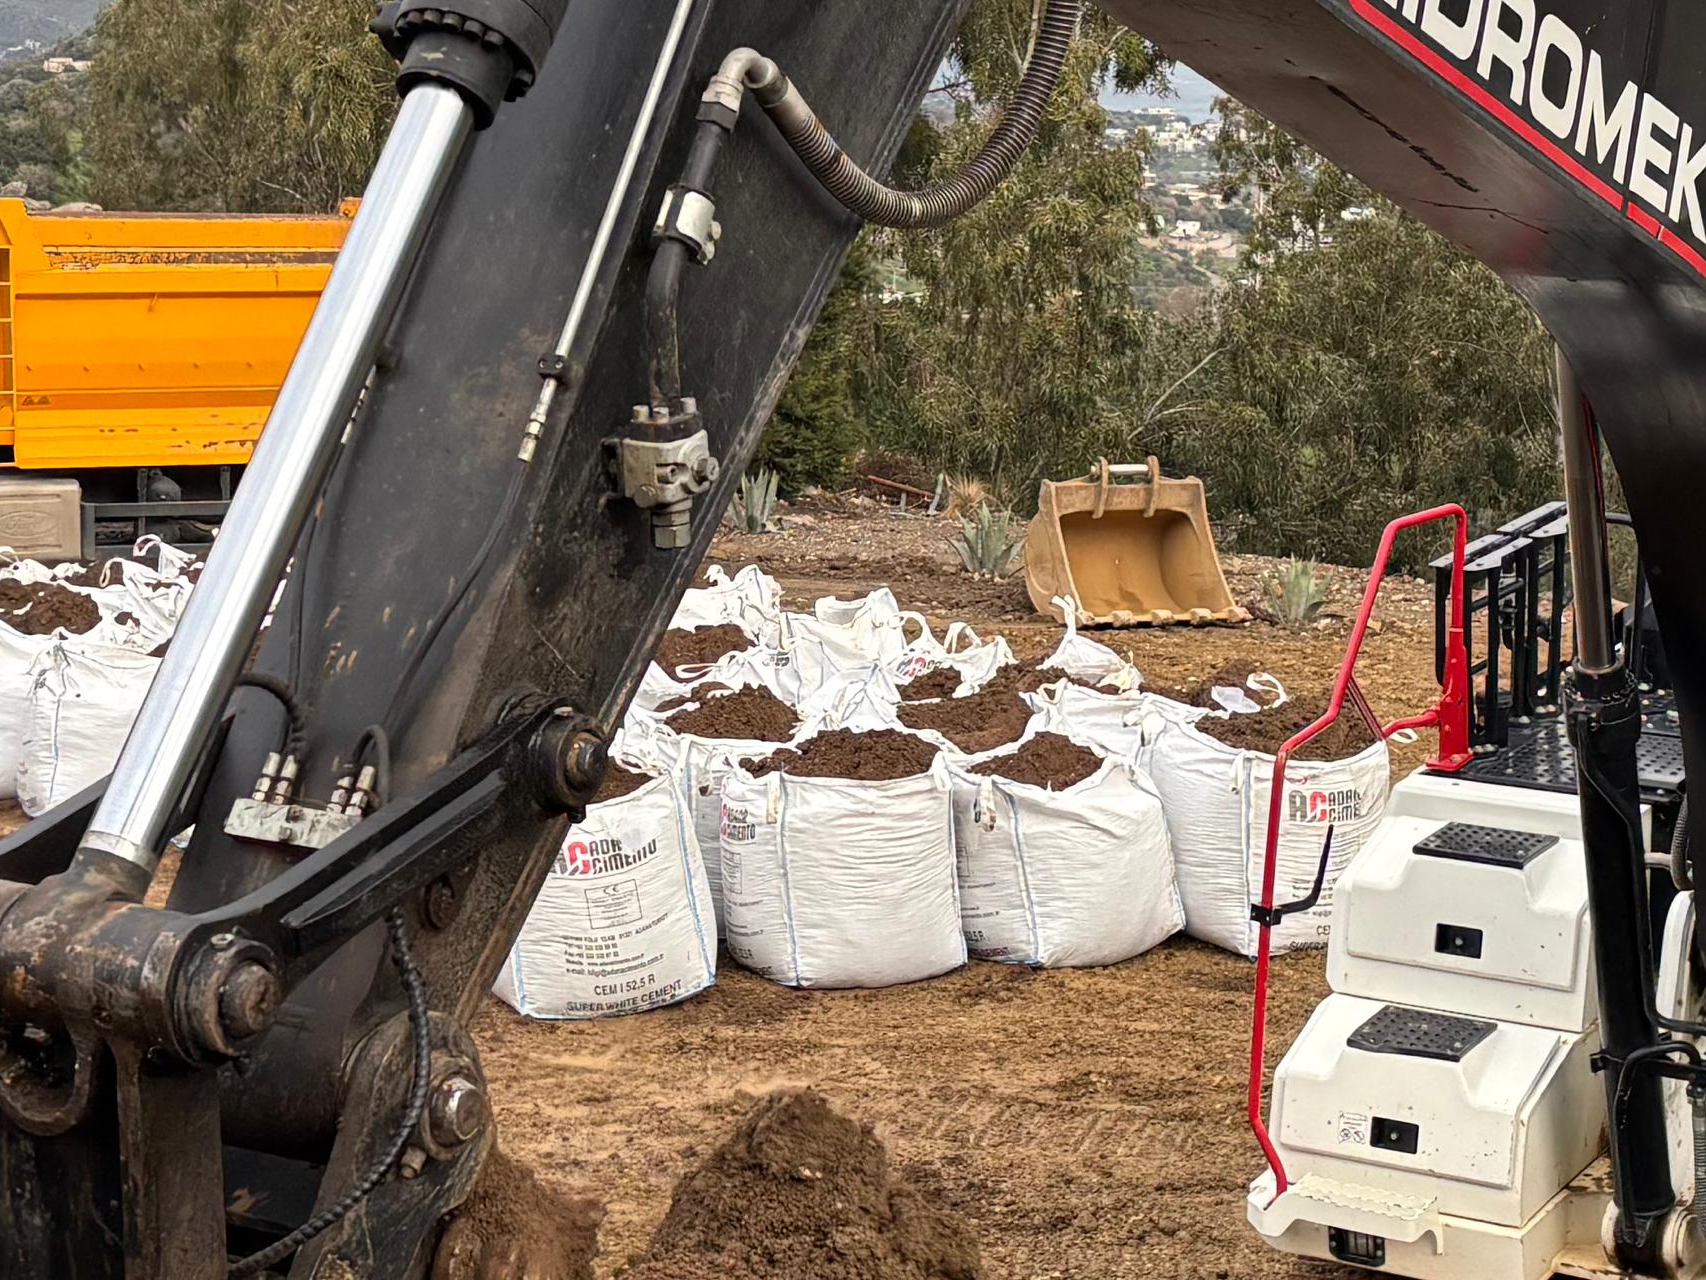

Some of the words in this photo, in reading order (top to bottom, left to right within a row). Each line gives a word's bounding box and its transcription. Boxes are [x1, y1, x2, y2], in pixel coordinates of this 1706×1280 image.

[566, 1000, 606, 1013] SUPER
[606, 997, 639, 1011] WHITE
[640, 979, 683, 1004] CEMENT
[594, 985, 618, 997] CEM
[648, 973, 657, 985] R
